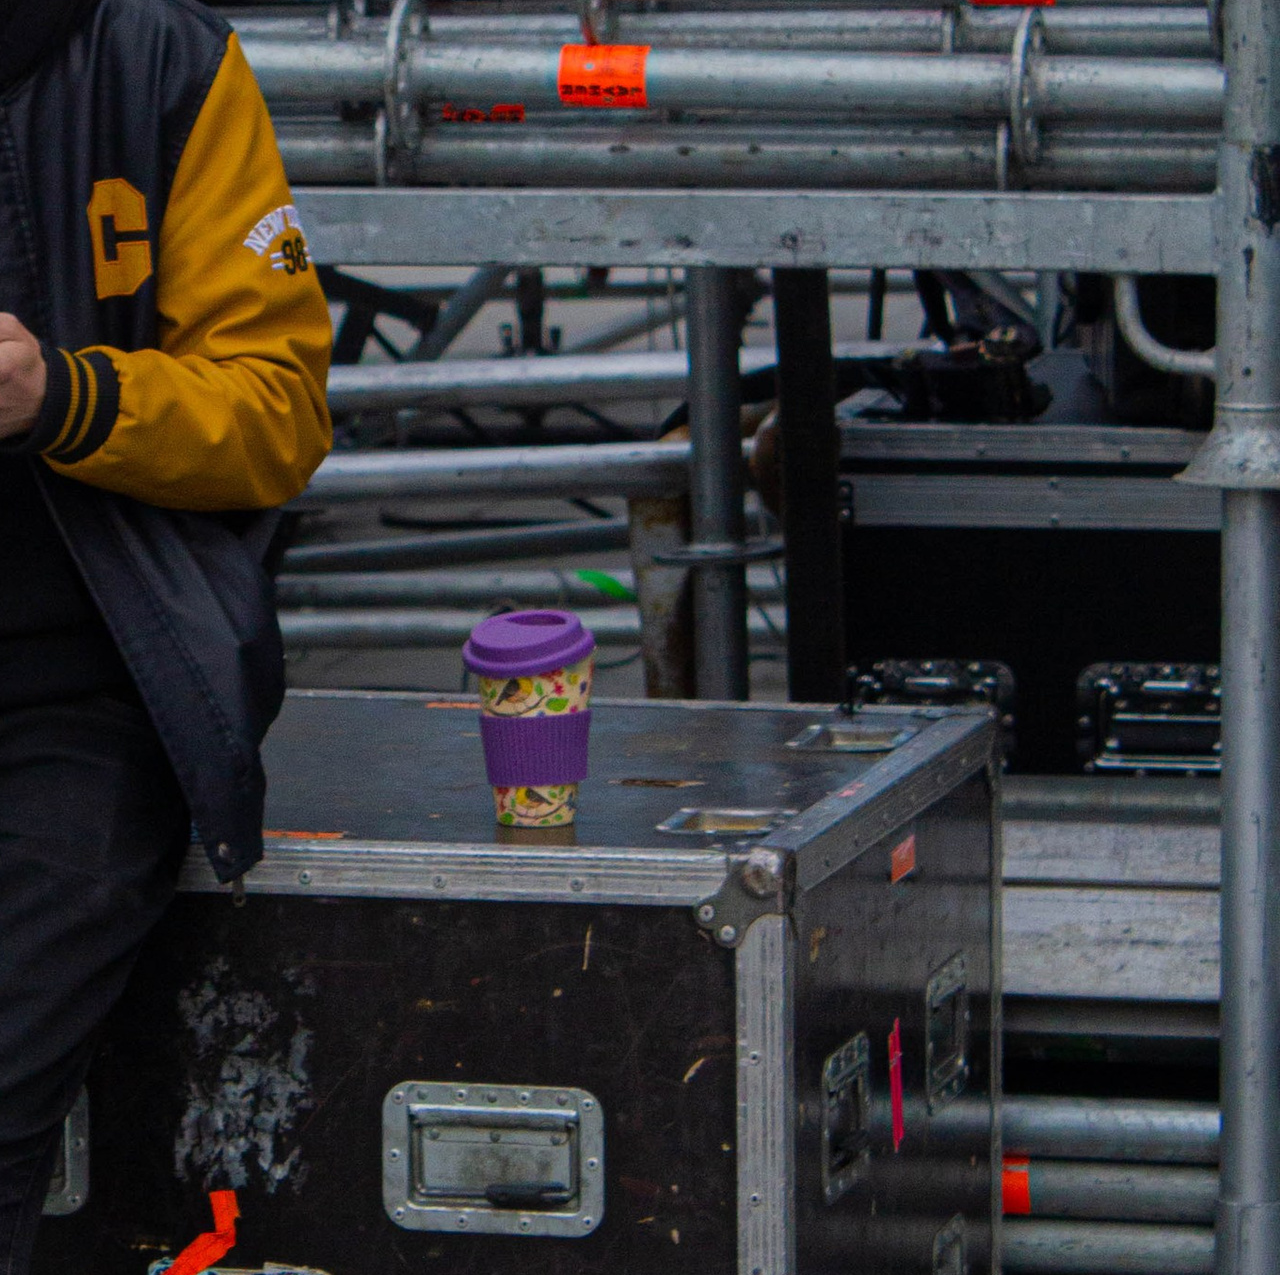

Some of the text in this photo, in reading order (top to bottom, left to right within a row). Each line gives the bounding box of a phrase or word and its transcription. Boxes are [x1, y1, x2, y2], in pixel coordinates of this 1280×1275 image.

[87, 178, 153, 300] C
[243, 206, 286, 257] NEW
[282, 237, 308, 275] 98
